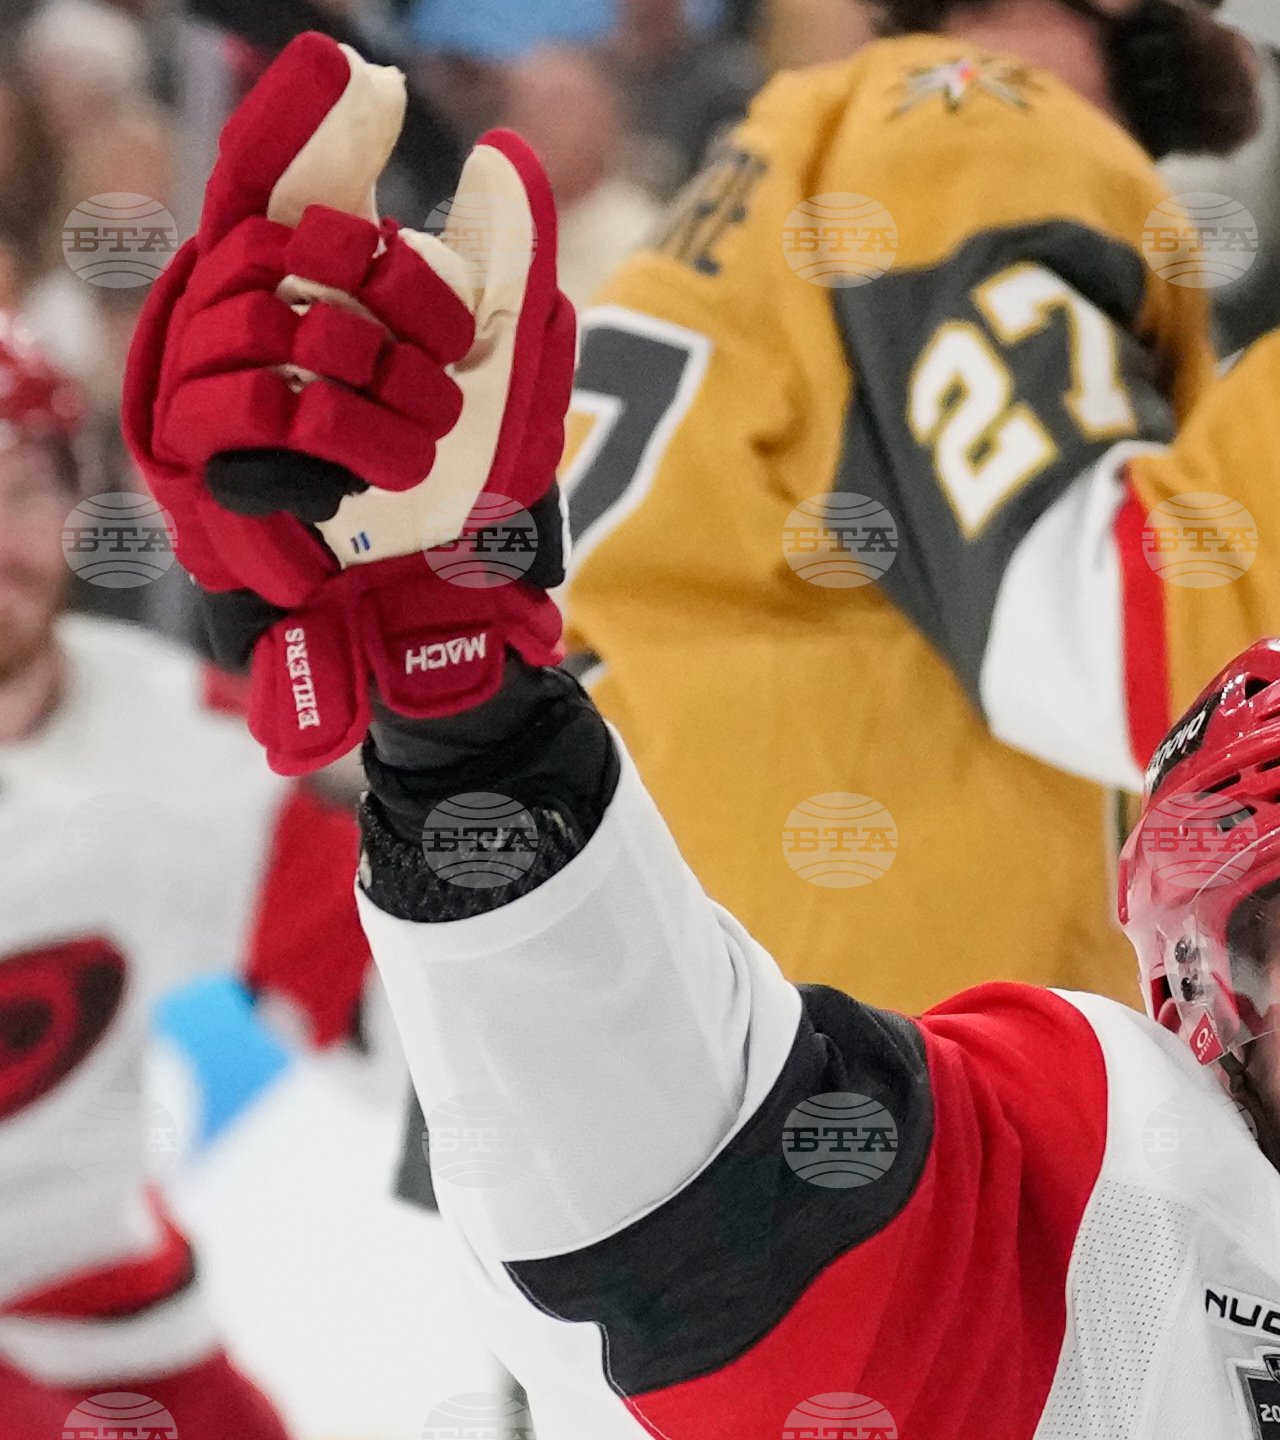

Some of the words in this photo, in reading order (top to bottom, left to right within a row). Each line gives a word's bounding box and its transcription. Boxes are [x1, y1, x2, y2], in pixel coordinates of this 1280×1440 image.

[906, 259, 1137, 542] 27
[284, 627, 321, 730] EHLERS
[405, 632, 487, 675] MACH
